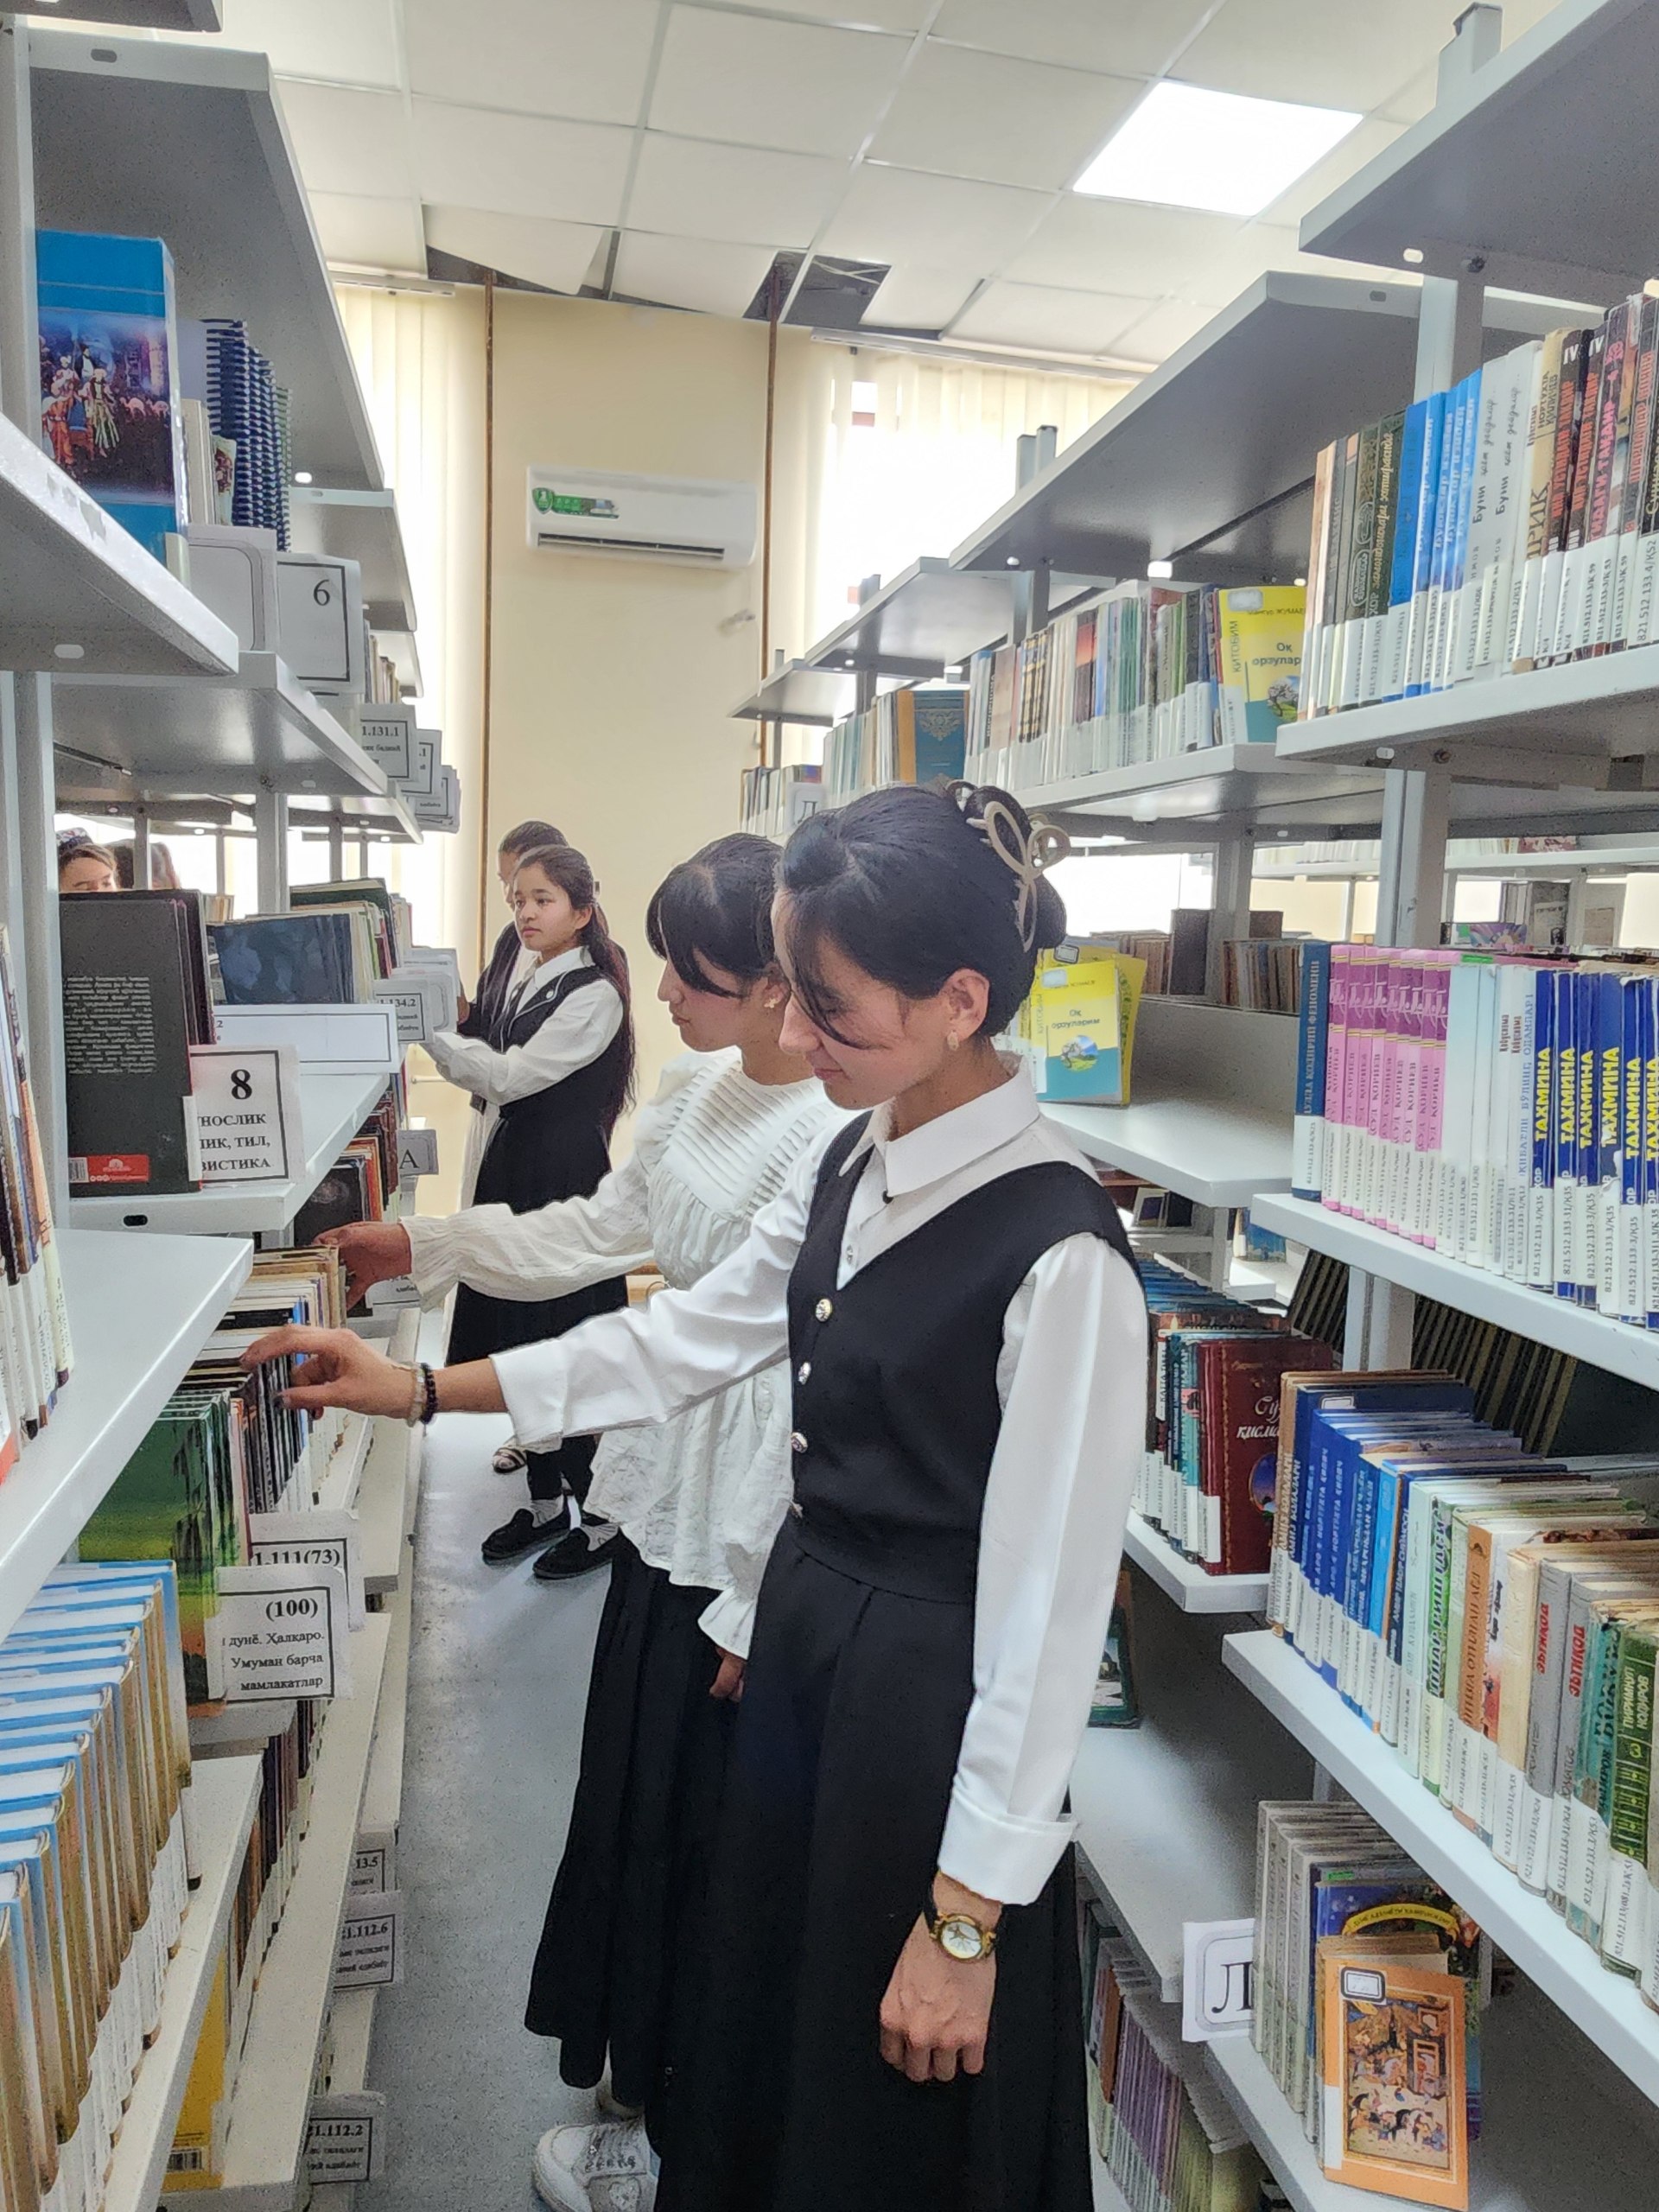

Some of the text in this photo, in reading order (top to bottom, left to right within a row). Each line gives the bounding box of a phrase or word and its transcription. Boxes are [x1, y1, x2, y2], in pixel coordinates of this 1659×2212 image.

[1563, 343, 1580, 365] IV
[1588, 334, 1605, 356] IV
[1471, 486, 1486, 524] Буни
[1495, 476, 1510, 515] Буни
[313, 579, 332, 606] 6
[1231, 619, 1242, 673] КИТОБИМ
[1276, 642, 1293, 652] Оқ
[231, 1069, 252, 1100] 8
[1535, 1046, 1550, 1141] ТАХМИНА
[1560, 1046, 1575, 1143] ТАХМИНА
[1580, 1048, 1593, 1149] ТАХМИНА
[1625, 1057, 1640, 1160] ТАХМИНА
[234, 1135, 270, 1147] ТИЛ,
[1517, 1116, 1529, 1176] ҚИБАТЛИ
[399, 1147, 420, 1170] А
[265, 1598, 319, 1623] (100)
[228, 1631, 324, 1647] дунё. Ҳалқаро.
[231, 1653, 323, 1669] Умуман барча
[240, 1677, 323, 1692] мамлакатлар
